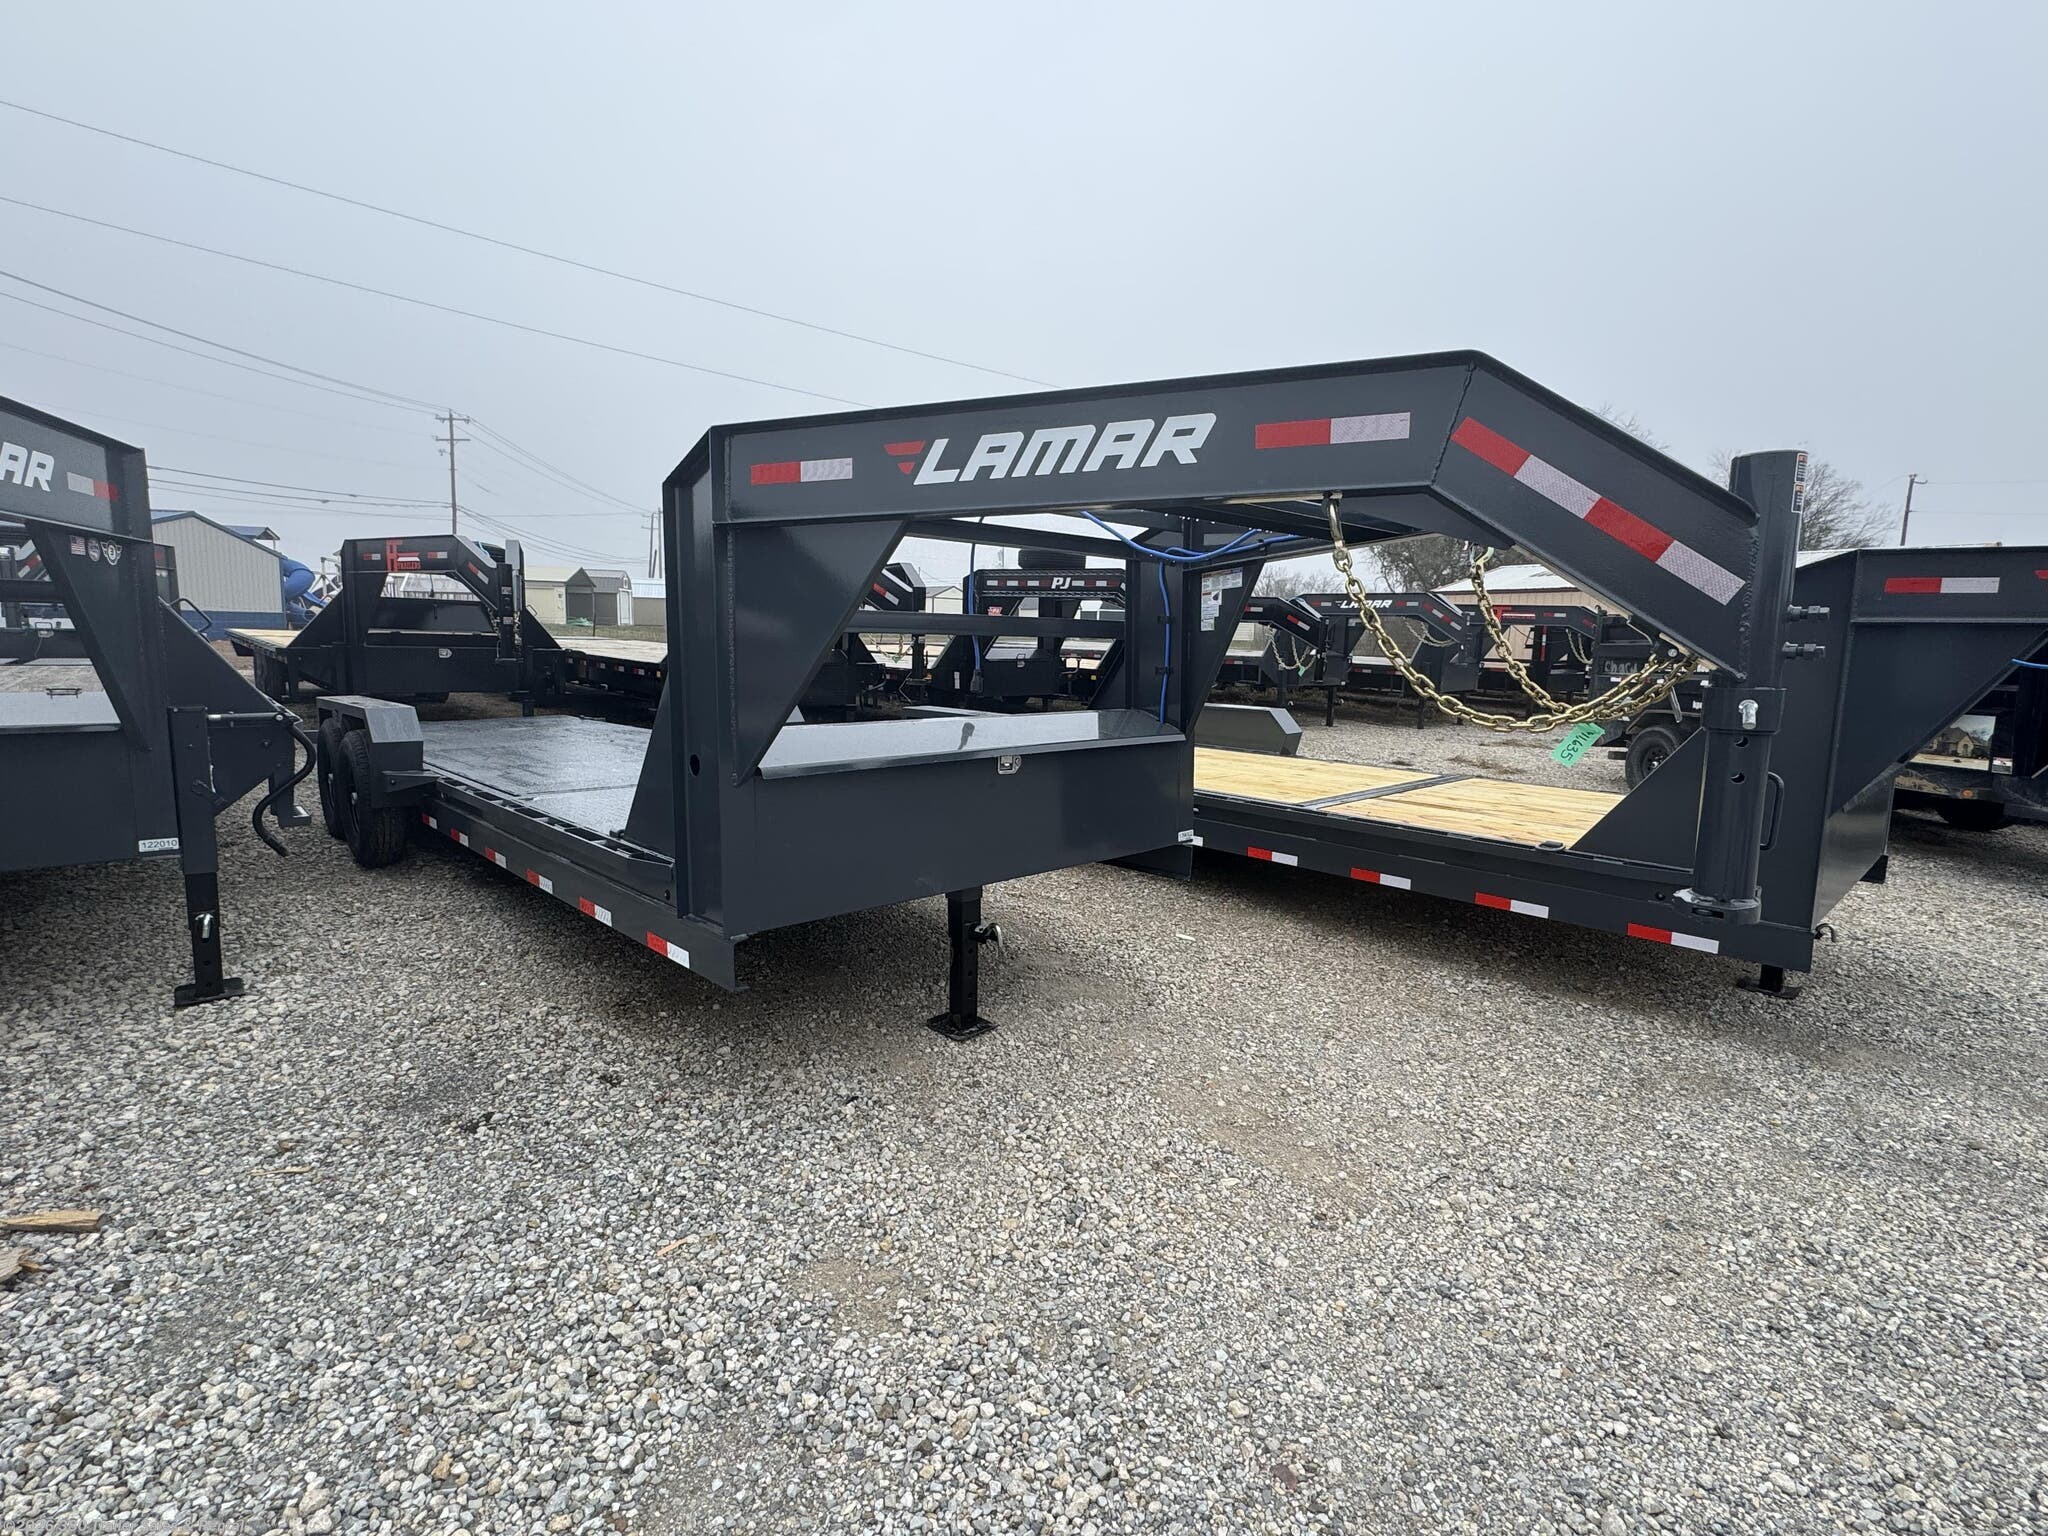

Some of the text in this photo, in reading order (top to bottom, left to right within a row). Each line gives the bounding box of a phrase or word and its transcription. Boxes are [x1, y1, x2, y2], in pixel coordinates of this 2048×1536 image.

[912, 412, 1217, 485] LAMAR
[1051, 577, 1071, 589] PJ
[142, 839, 178, 849] 122010
